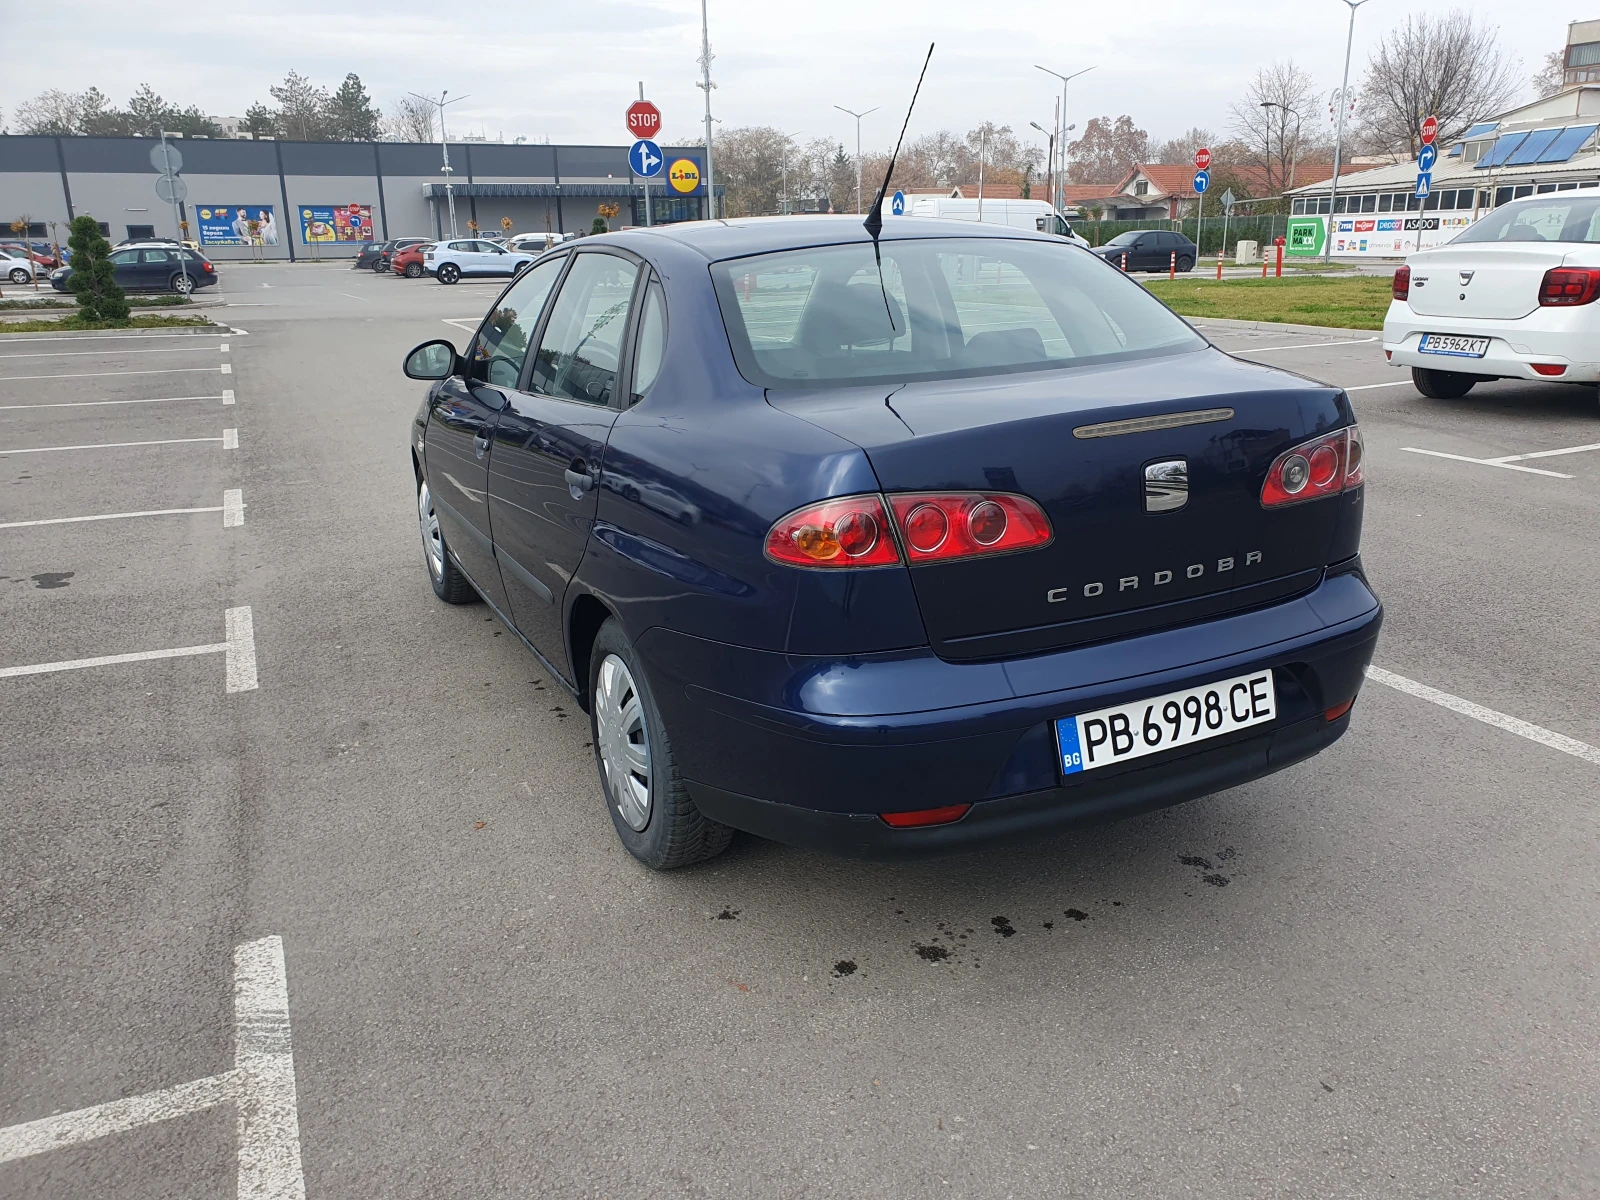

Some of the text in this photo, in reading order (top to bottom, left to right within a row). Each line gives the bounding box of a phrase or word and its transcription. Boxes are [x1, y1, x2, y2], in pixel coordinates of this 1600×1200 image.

[630, 113, 658, 127] STOP
[1423, 125, 1436, 136] STOP
[1196, 154, 1209, 163] STOP
[1379, 221, 1401, 230] pepco
[1406, 219, 1434, 229] ASADO
[1293, 228, 1313, 236] PARK
[1292, 236, 1313, 244] MAXX
[1426, 336, 1486, 352] PB 5962 KT
[1047, 550, 1263, 603] CORDOBA
[1083, 676, 1271, 763] PB 6998 CE
[1064, 752, 1081, 768] BG
